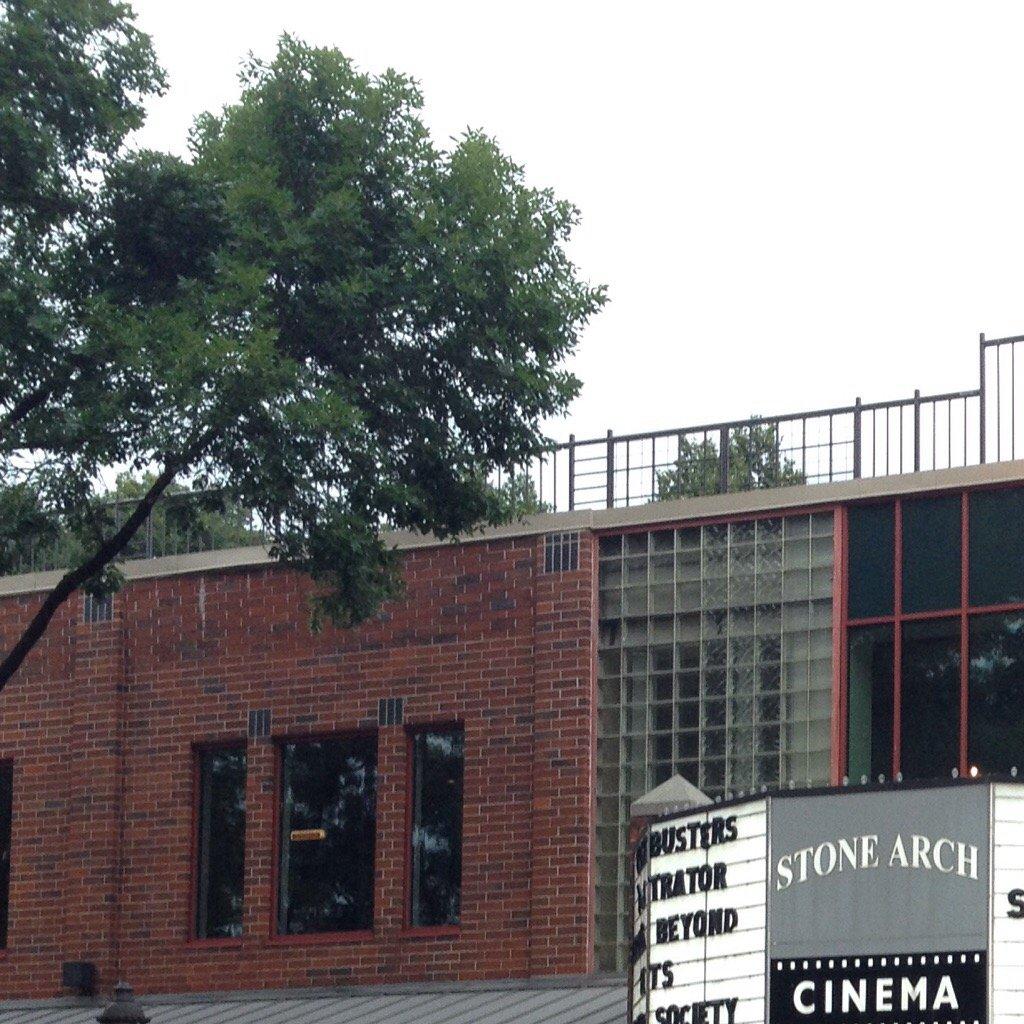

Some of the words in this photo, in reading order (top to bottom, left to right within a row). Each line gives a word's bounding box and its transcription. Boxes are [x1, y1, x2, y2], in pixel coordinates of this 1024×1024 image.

[777, 834, 879, 891] STONE
[890, 833, 979, 880] ARCH
[656, 908, 738, 945] BEYOND
[793, 975, 959, 1014] CINEMA
